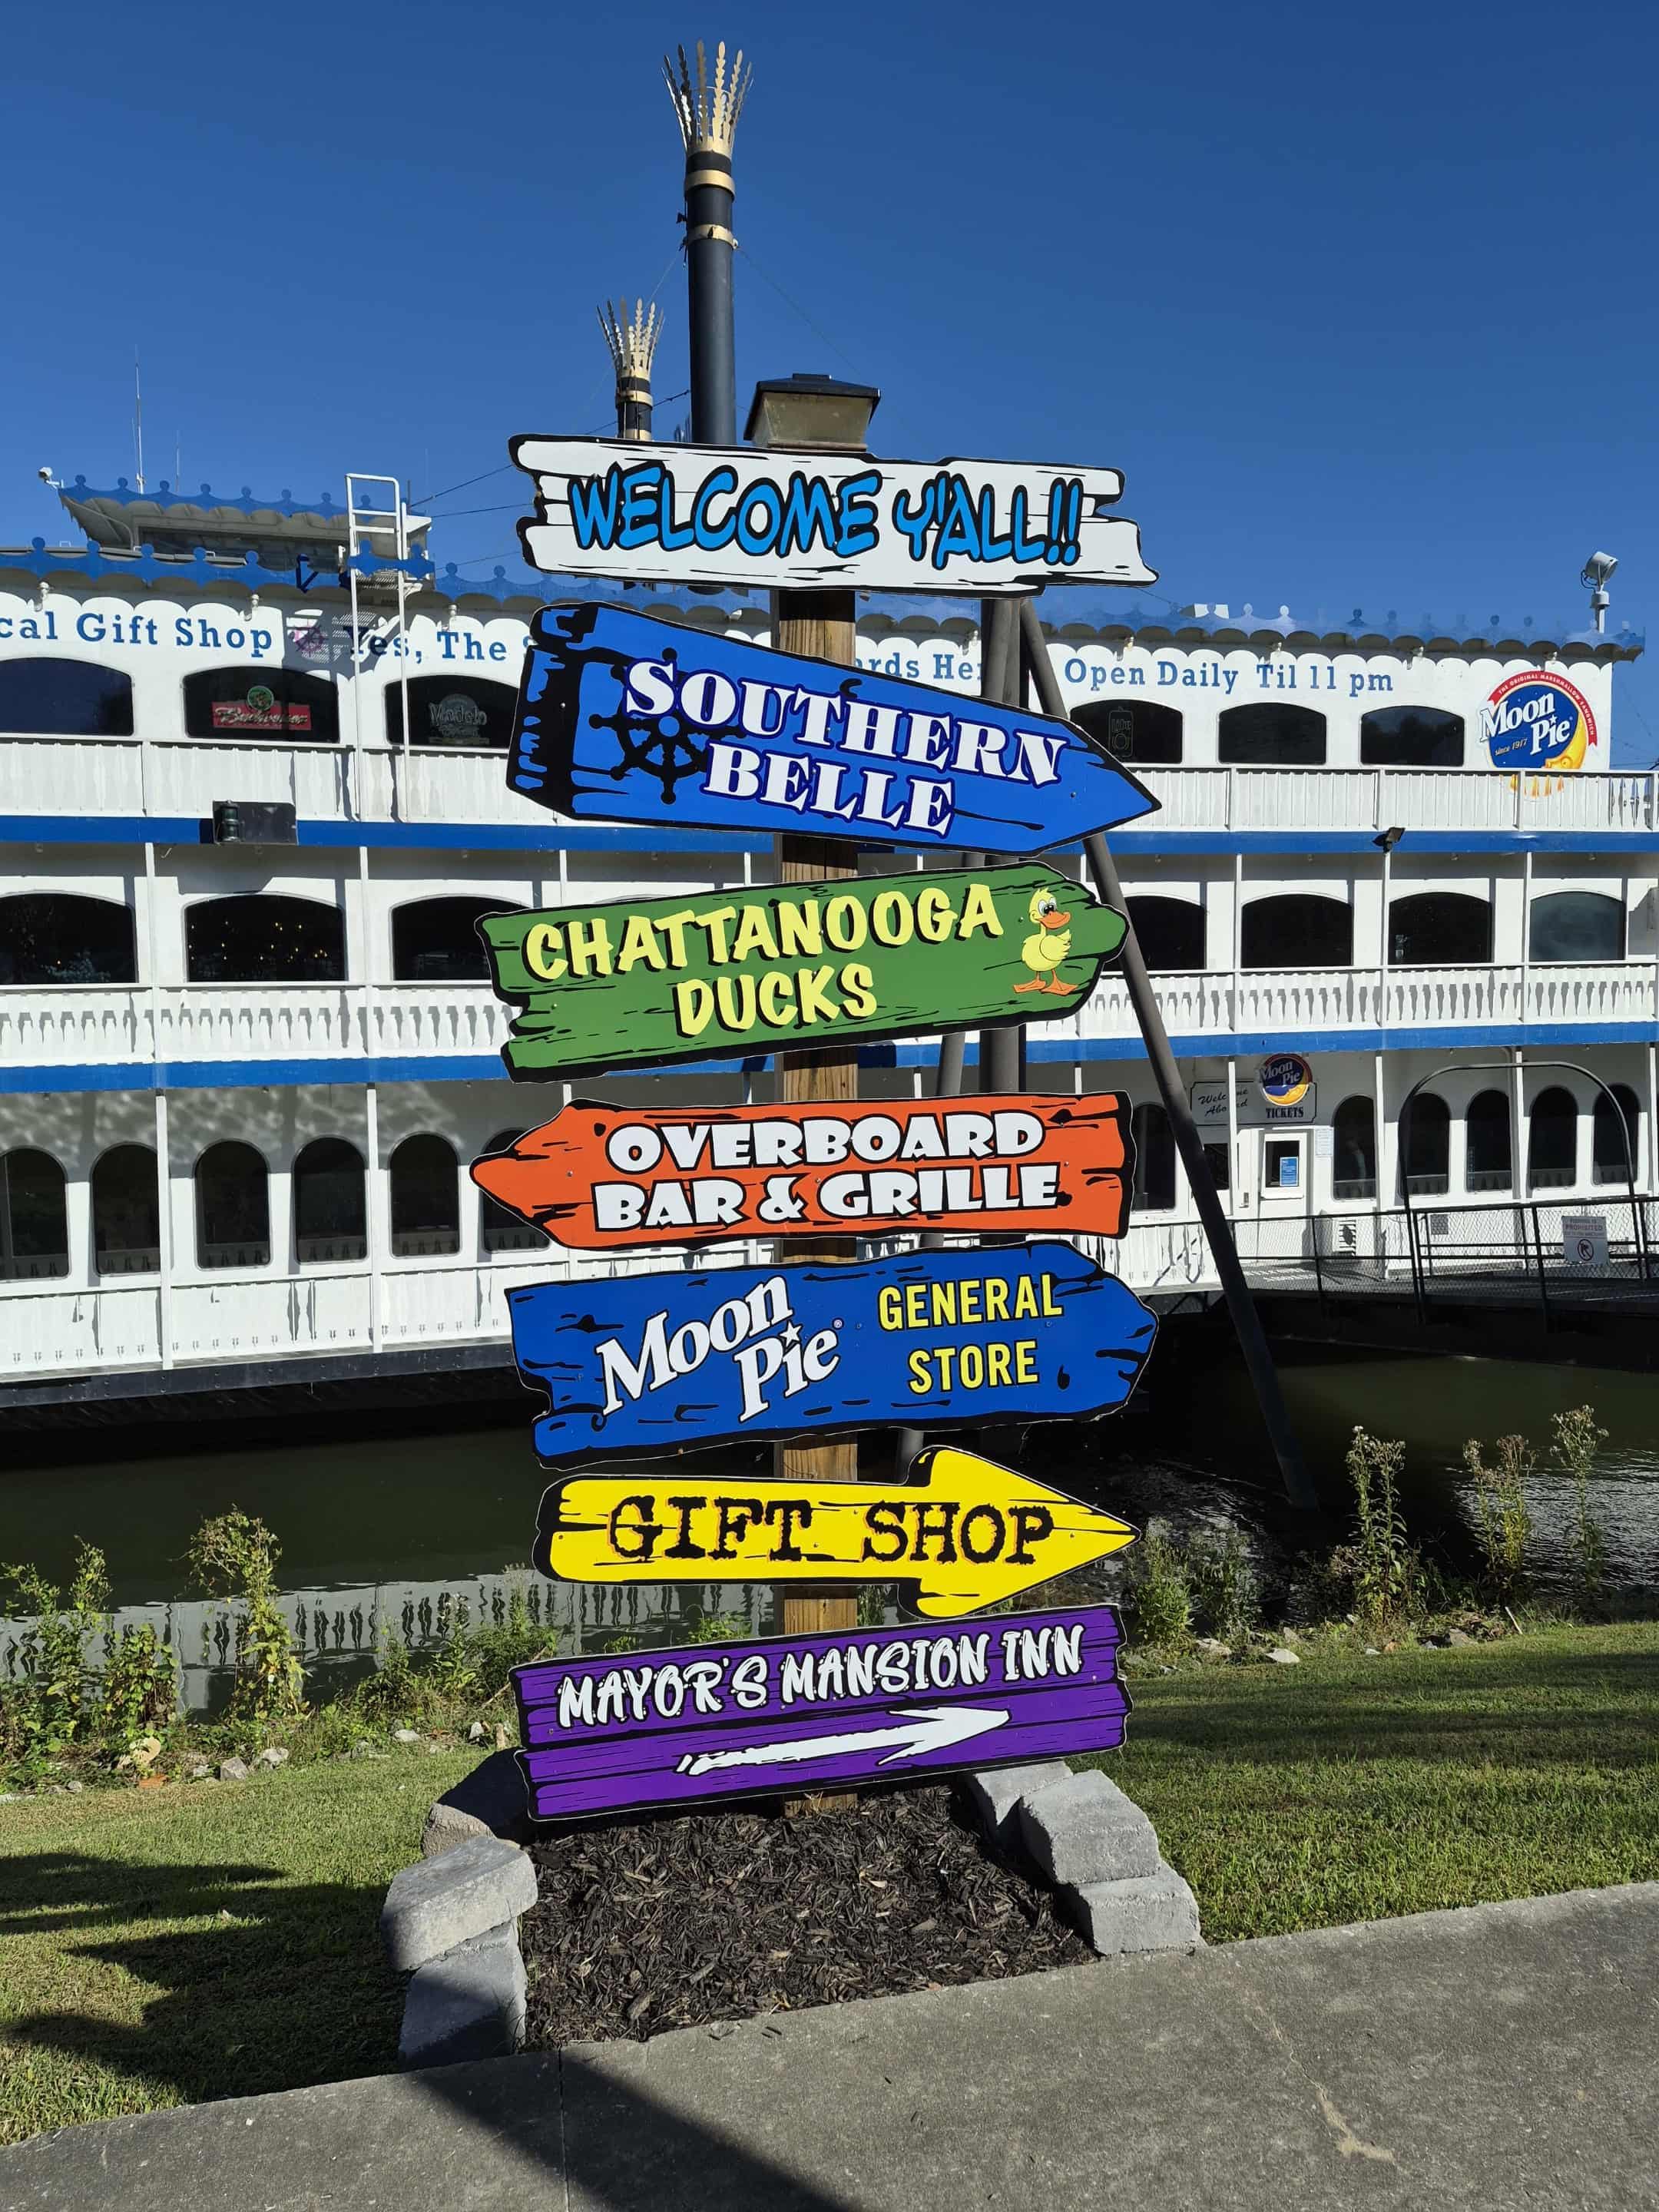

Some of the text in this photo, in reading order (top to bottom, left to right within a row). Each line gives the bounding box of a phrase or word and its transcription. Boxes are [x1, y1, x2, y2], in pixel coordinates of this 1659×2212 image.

[571, 463, 1082, 568] WELCOME Y'ALL!!
[76, 613, 157, 645] Gift
[175, 618, 272, 657] Shop
[436, 631, 507, 661] The
[1065, 658, 1145, 691] Open
[1157, 661, 1239, 694] Daily
[1257, 664, 1297, 689] Til
[1349, 673, 1393, 697] pm
[625, 658, 1068, 786] SOUTHERN
[1480, 692, 1555, 742] Moon
[1512, 738, 1528, 750] 1917
[1529, 714, 1571, 755] Pie
[704, 742, 955, 836] BELLE
[525, 883, 1003, 980] CHATTANOOGA
[677, 964, 877, 1035] DUCKS
[1260, 1061, 1293, 1079] Moon
[1283, 1071, 1300, 1085] Pie
[1267, 1107, 1304, 1119] TICKETS
[608, 1111, 1043, 1172] OVERBOARD
[594, 1164, 1058, 1230] BAR & GRILLE
[879, 1274, 1062, 1330] GENERAL
[595, 1276, 792, 1414] Moon
[909, 1341, 1038, 1393] STORE
[608, 1495, 1054, 1565] GIFT SHOP
[558, 1625, 1084, 1727] MAYOR'S MANSION INN
